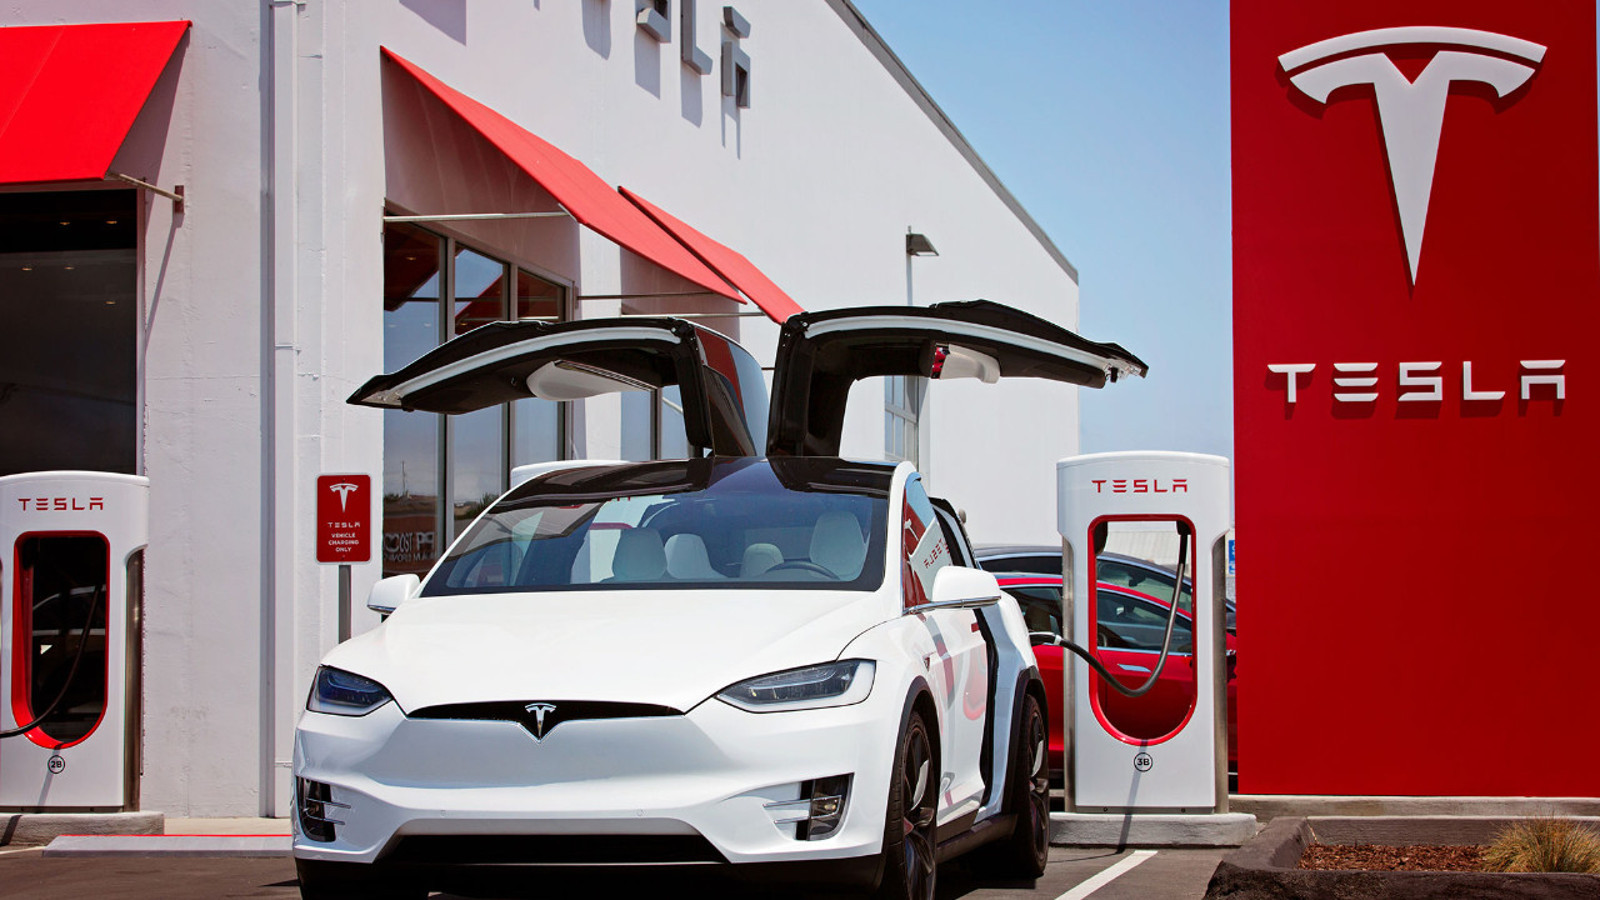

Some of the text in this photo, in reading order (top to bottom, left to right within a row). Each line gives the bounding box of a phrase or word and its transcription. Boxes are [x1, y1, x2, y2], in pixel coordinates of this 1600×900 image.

[1267, 359, 1566, 403] TESLA
[1091, 478, 1188, 493] TESLA
[17, 497, 104, 511] TESLA
[1137, 758, 1150, 766] 3B
